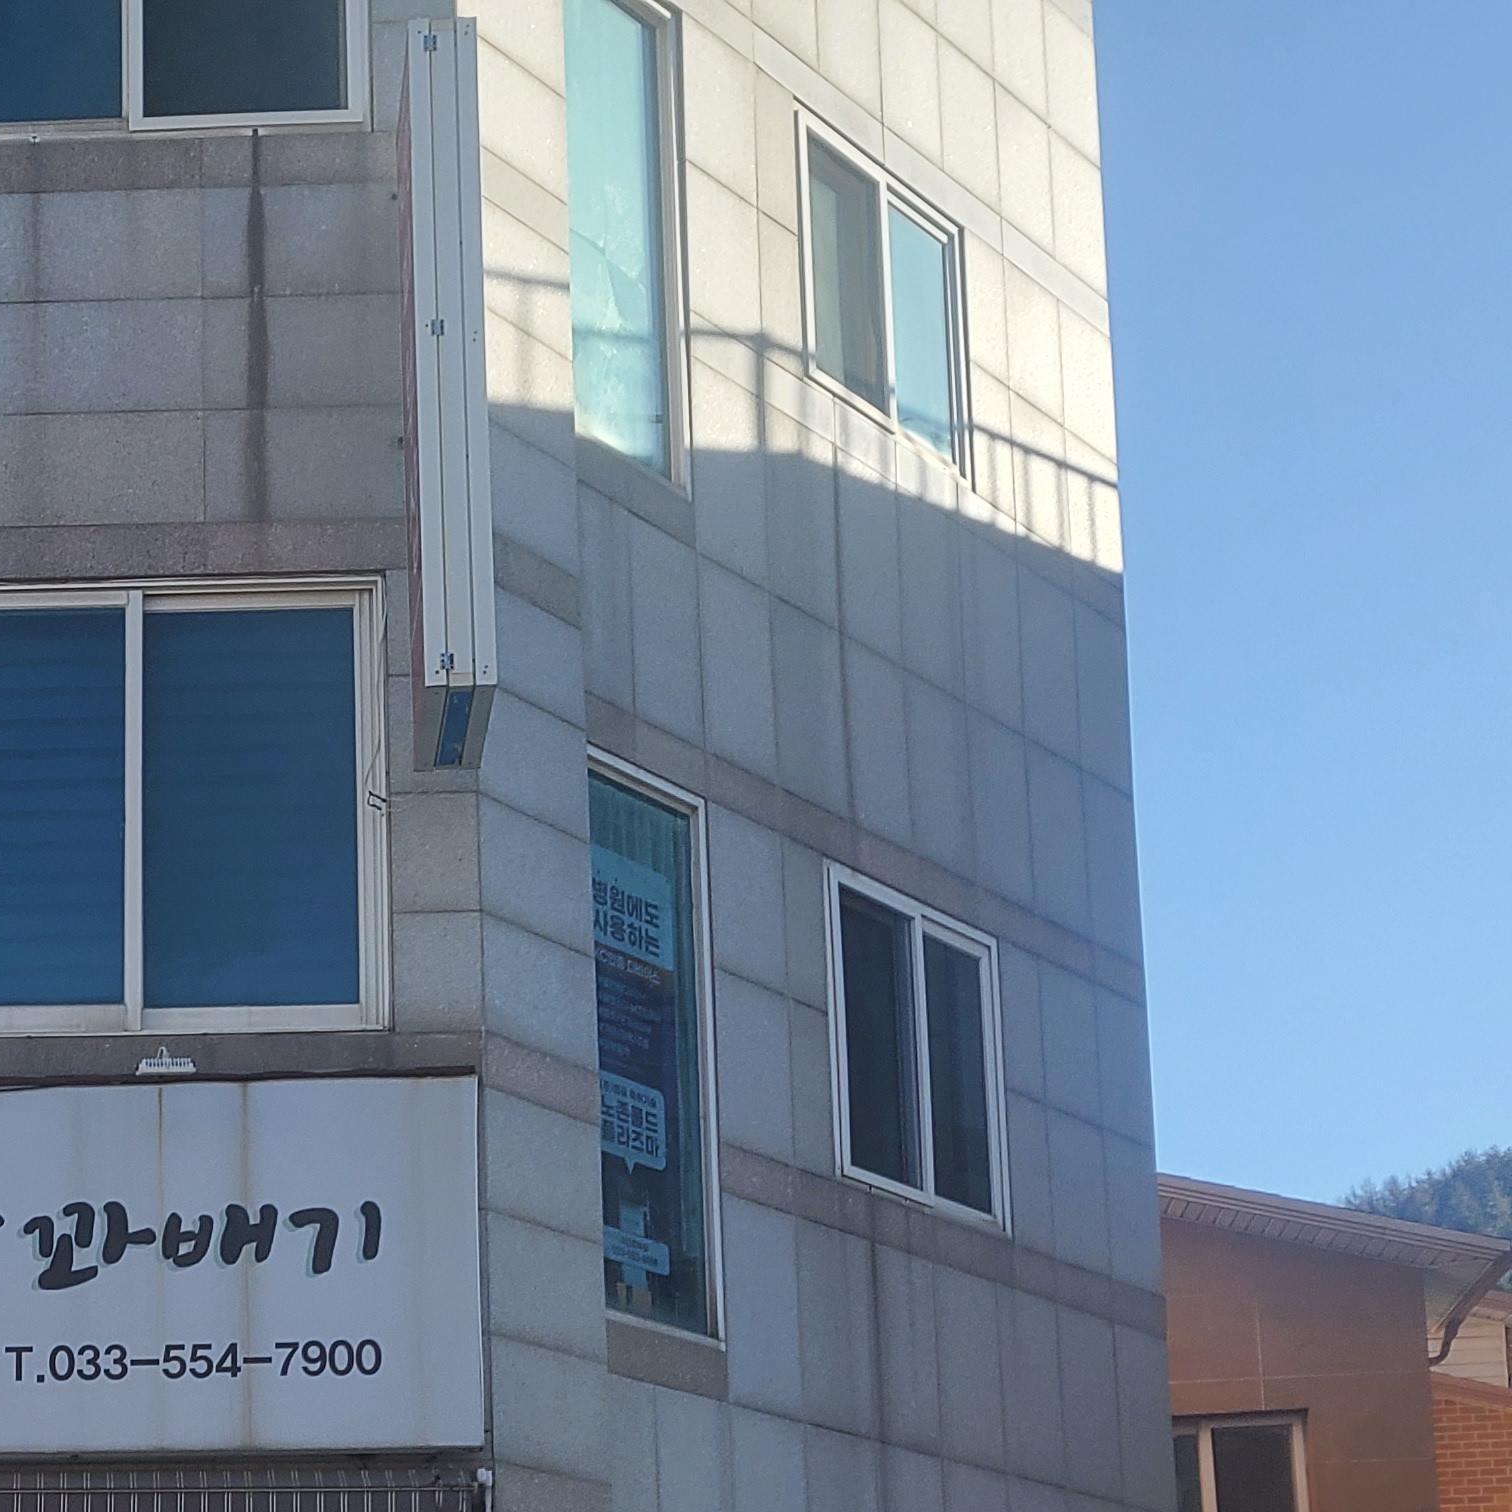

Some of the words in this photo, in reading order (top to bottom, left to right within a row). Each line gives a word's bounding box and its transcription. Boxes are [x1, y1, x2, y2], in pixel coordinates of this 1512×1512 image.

[593, 908, 660, 958] 사용하는
[21, 1200, 383, 1291] 꽈배기
[5, 1338, 383, 1384] T.033-554-7900
